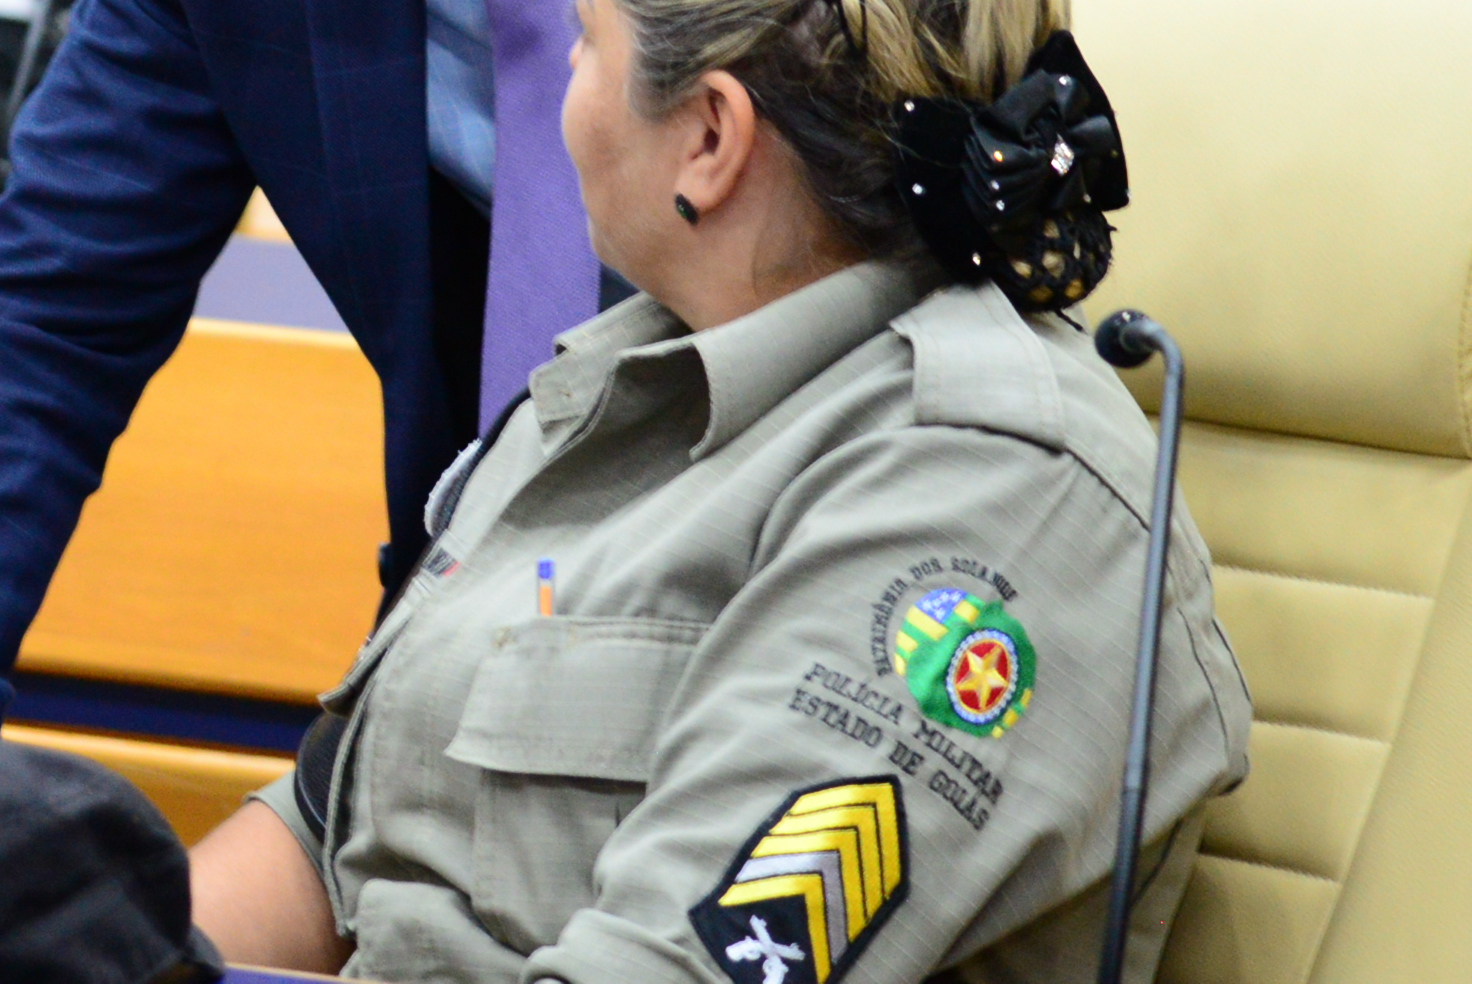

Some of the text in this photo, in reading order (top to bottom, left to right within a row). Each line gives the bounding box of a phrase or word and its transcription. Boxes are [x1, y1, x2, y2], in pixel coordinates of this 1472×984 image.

[789, 688, 883, 749] ESTADO
[888, 739, 925, 776] DE
[912, 720, 1004, 805] MILITAR
